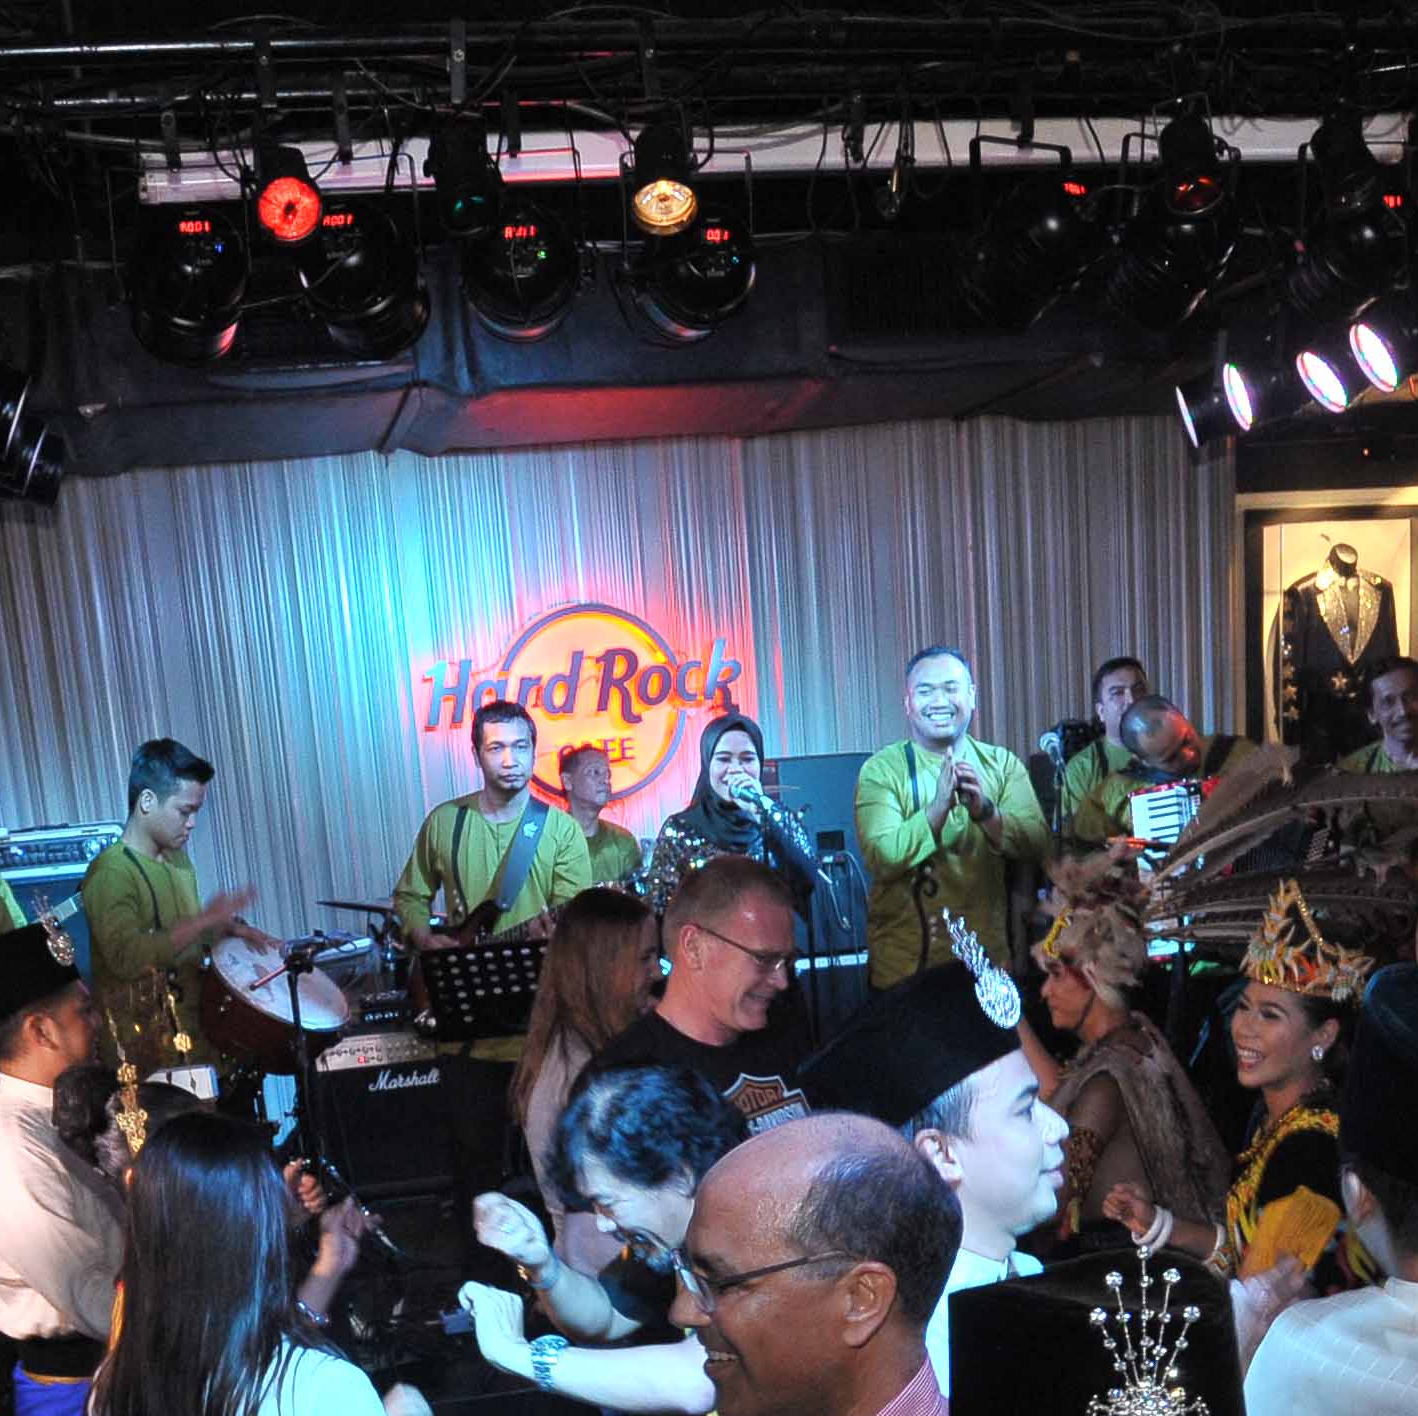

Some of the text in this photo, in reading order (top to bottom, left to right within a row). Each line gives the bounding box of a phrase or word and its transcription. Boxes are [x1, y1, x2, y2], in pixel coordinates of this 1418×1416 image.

[423, 637, 741, 729] Hard Rock
[368, 1067, 439, 1092] Marshall
